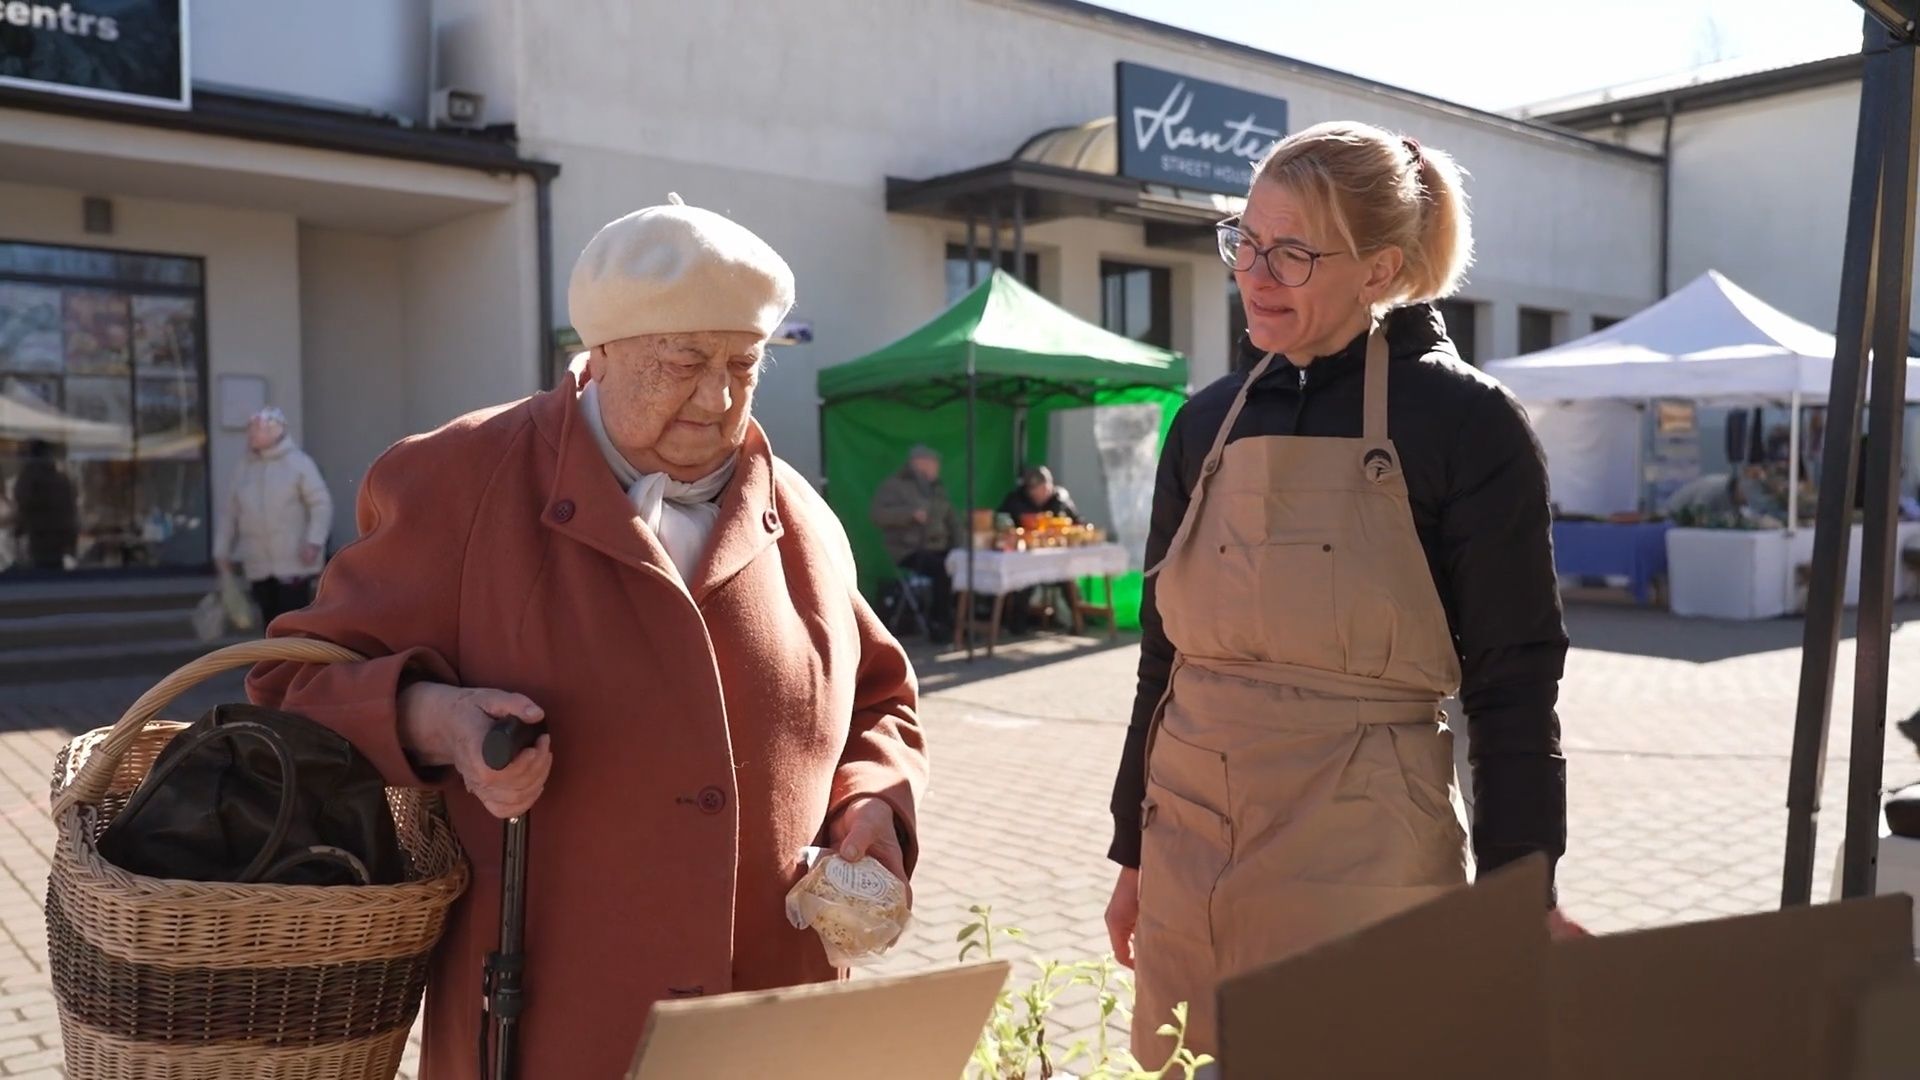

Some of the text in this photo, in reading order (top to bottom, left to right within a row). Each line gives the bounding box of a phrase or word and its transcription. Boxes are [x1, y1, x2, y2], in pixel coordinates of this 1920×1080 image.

[0, 1, 119, 41] entrs
[1133, 80, 1280, 160] Kante
[1161, 154, 1250, 186] STREET HOUS
